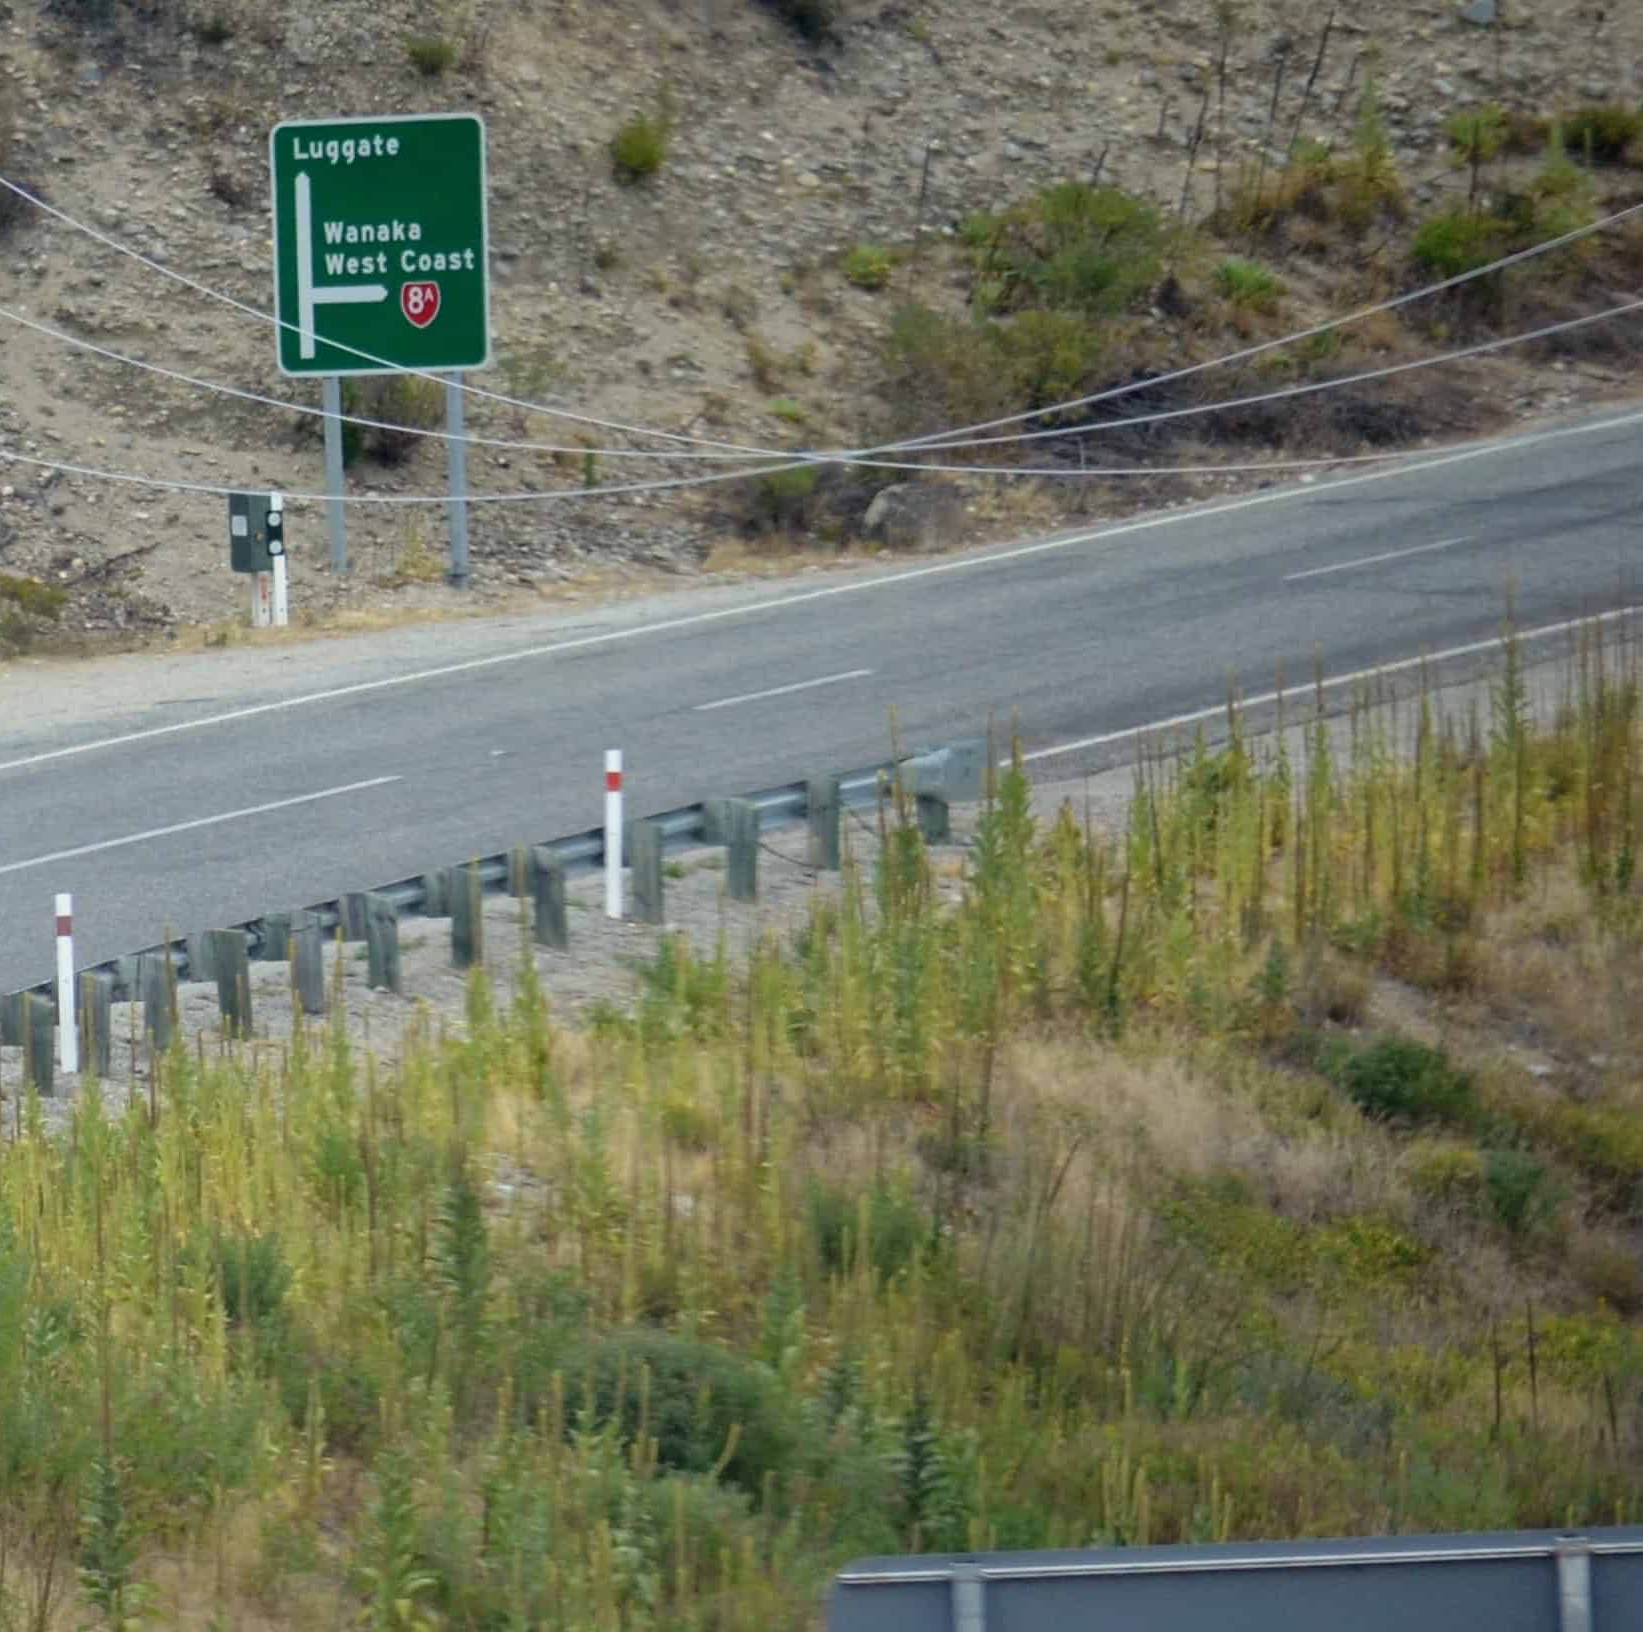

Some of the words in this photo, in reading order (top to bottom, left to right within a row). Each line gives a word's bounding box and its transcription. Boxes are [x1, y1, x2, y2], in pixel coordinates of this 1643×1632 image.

[293, 134, 400, 165] Luggate
[324, 220, 421, 244] Wanaka
[325, 253, 387, 275] West
[401, 248, 474, 271] Coast
[408, 286, 434, 315] 8A
